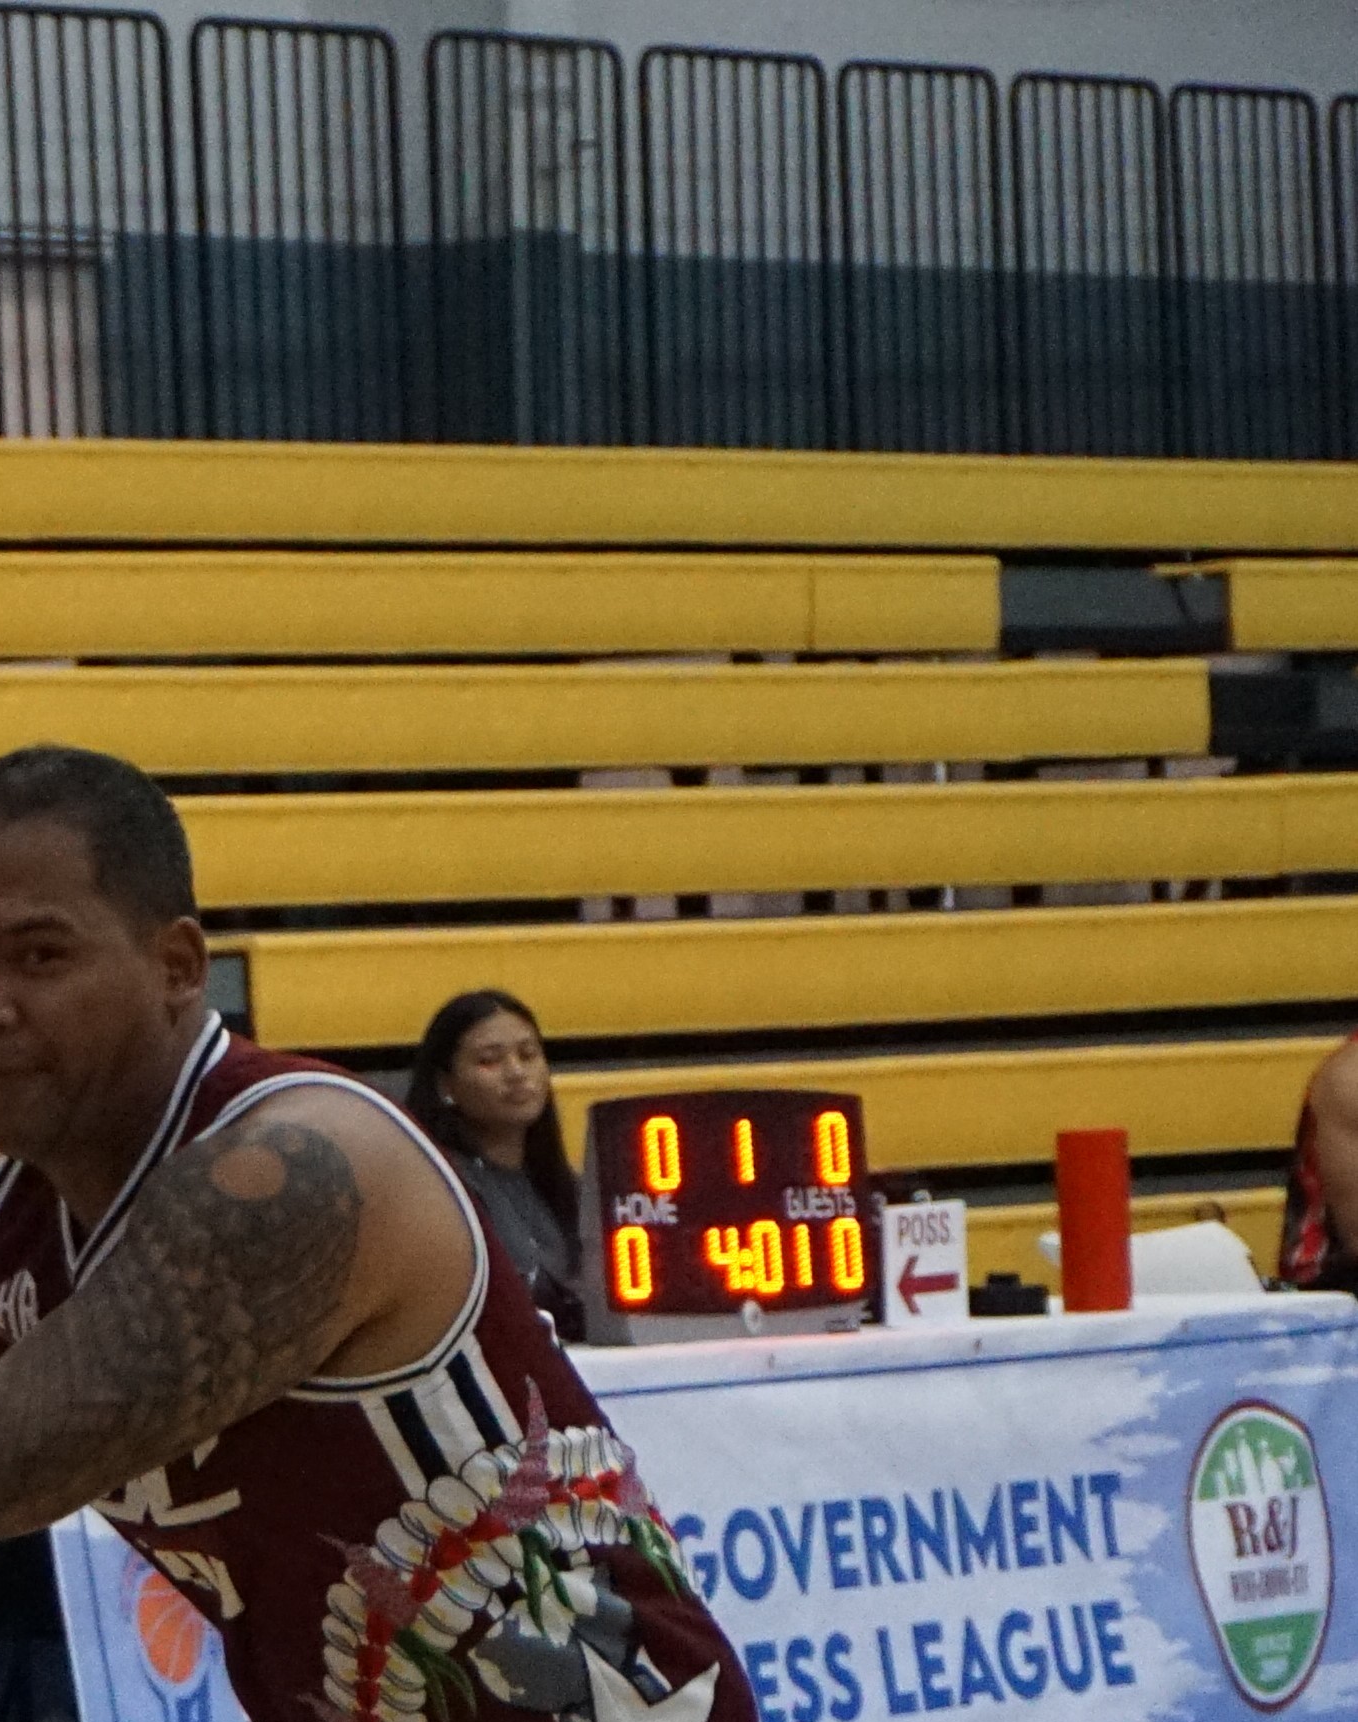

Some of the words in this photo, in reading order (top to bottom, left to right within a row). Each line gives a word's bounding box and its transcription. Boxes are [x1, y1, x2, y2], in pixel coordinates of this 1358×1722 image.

[643, 1115, 682, 1190] 0
[735, 1118, 756, 1184] 1
[816, 1110, 852, 1185] 0
[615, 1193, 678, 1225] HOME
[896, 1212, 951, 1247] POSS
[614, 1225, 653, 1300] 0
[674, 1473, 1121, 1600] GOVERNMENT
[878, 1602, 1134, 1717] LEAGUE
